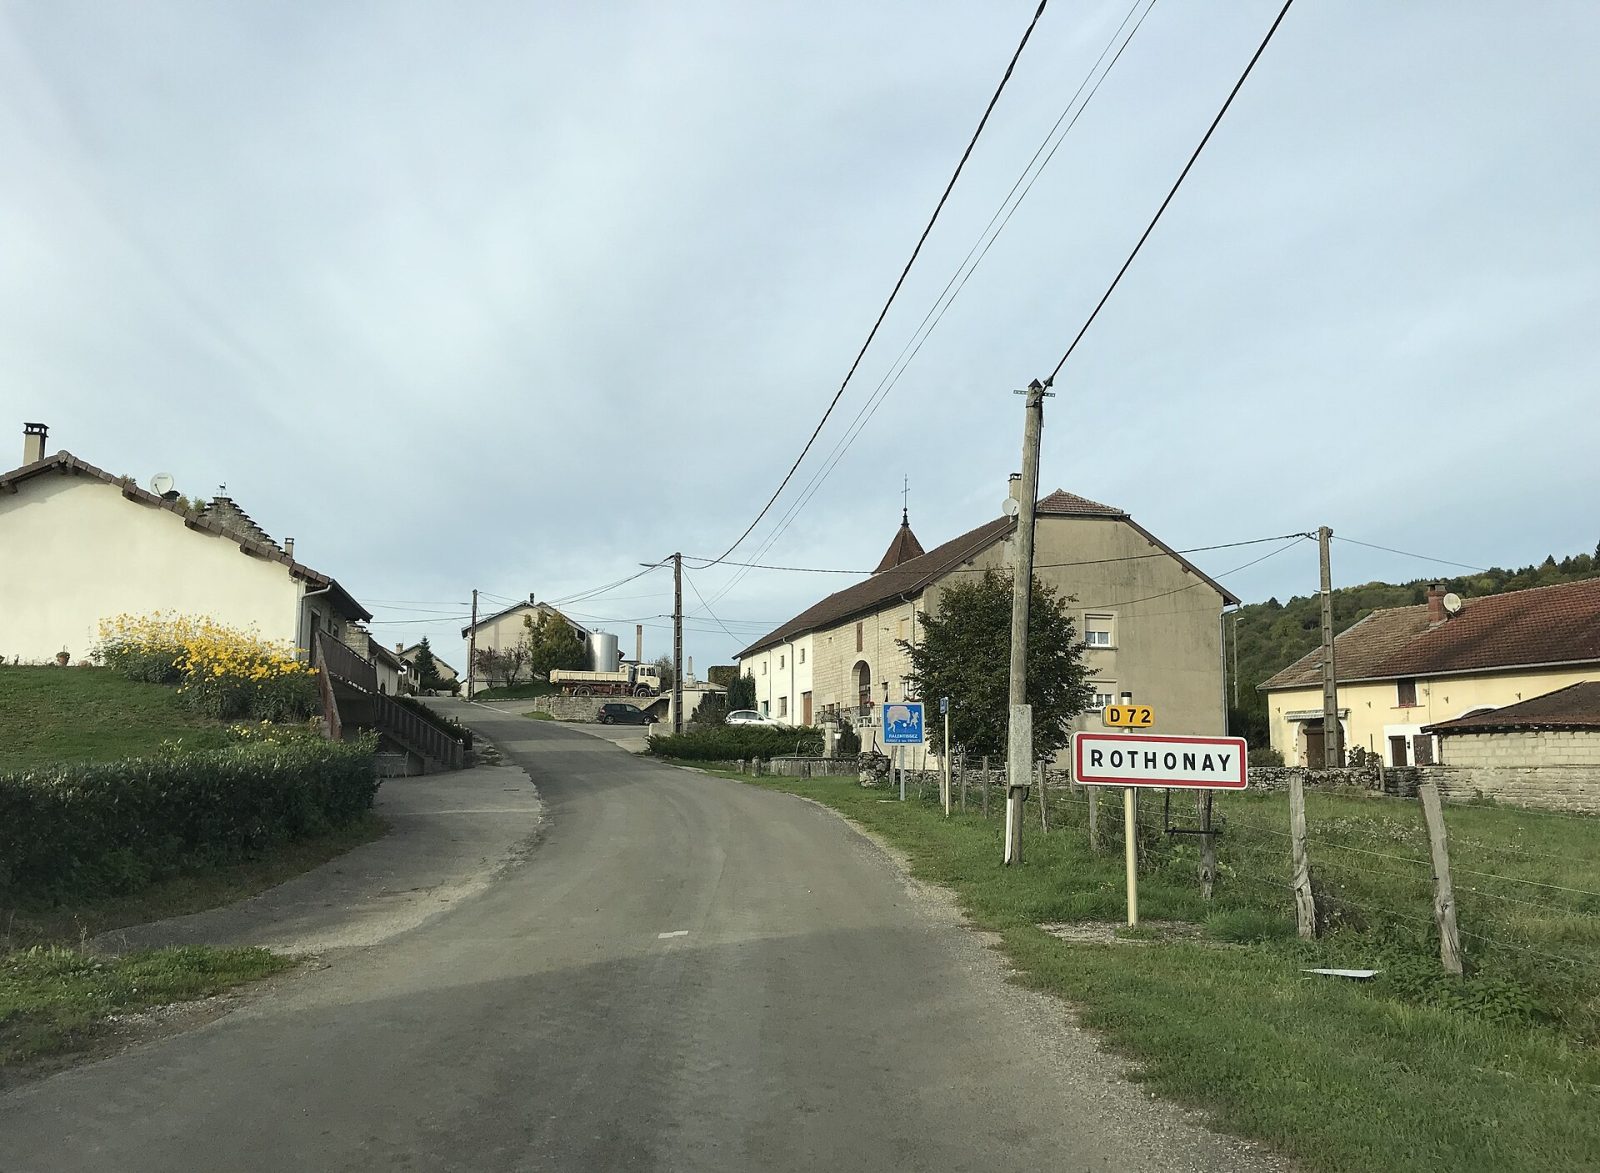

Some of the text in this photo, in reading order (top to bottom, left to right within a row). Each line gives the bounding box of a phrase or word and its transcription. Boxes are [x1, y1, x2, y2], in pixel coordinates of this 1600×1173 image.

[1110, 708, 1151, 723] D 72
[1090, 749, 1231, 772] ROTHONAY
